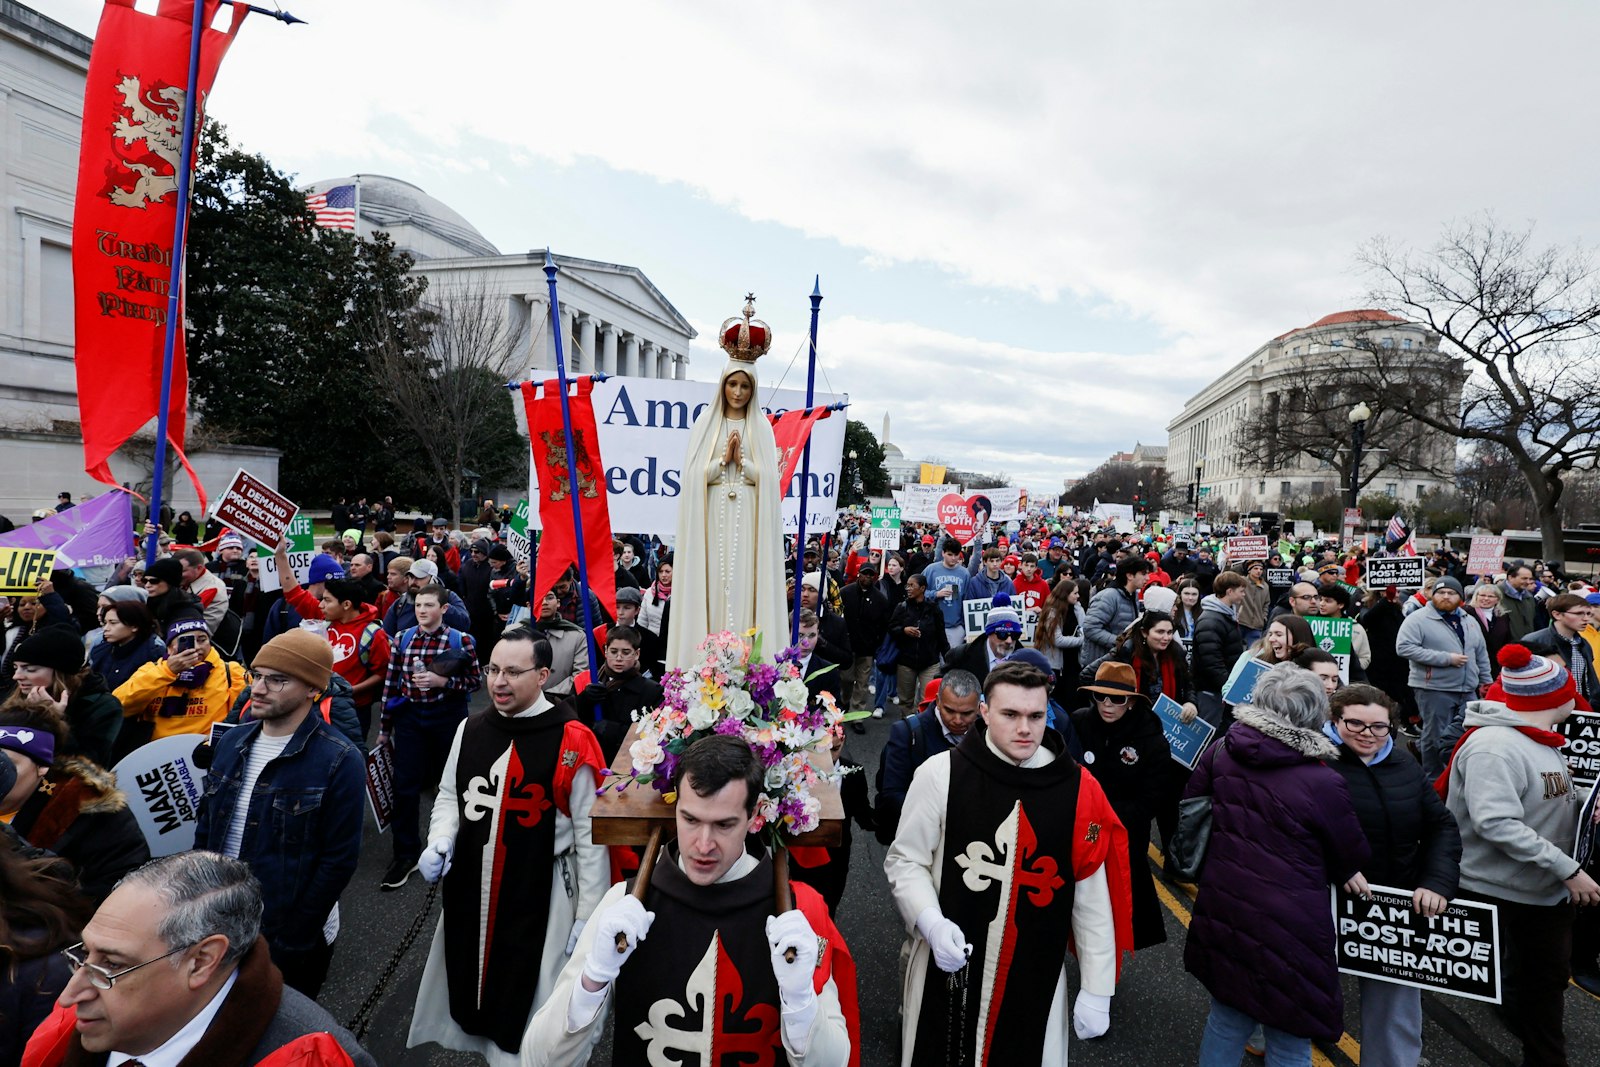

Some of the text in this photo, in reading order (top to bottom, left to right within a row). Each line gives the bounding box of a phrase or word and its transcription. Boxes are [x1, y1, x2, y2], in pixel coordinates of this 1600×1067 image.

[240, 484, 287, 518] I DEMAND
[942, 505, 967, 514] LOVE
[227, 490, 288, 533] PROTECTION
[873, 509, 900, 519] LOVE LIFE
[944, 516, 972, 526] BOTH
[223, 504, 279, 541] AT CONCEPTION
[288, 519, 311, 536] LIFE
[873, 530, 897, 539] CHOOSE
[879, 540, 891, 549] LIFE
[1369, 569, 1423, 578] POST-ROE
[1371, 577, 1421, 585] GENERATION
[1310, 620, 1351, 637] OVE LIFE
[1565, 723, 1571, 735] I
[1162, 729, 1189, 753] acred.
[160, 762, 196, 823] ABORTION
[368, 762, 388, 810] DEMAND
[135, 768, 182, 836] MAKE
[1346, 900, 1480, 937] I AM THE
[1340, 917, 1492, 962] POST-ROE
[1343, 941, 1489, 984] GENERATION
[1382, 966, 1448, 985] TEXT LIFE TO 53445
